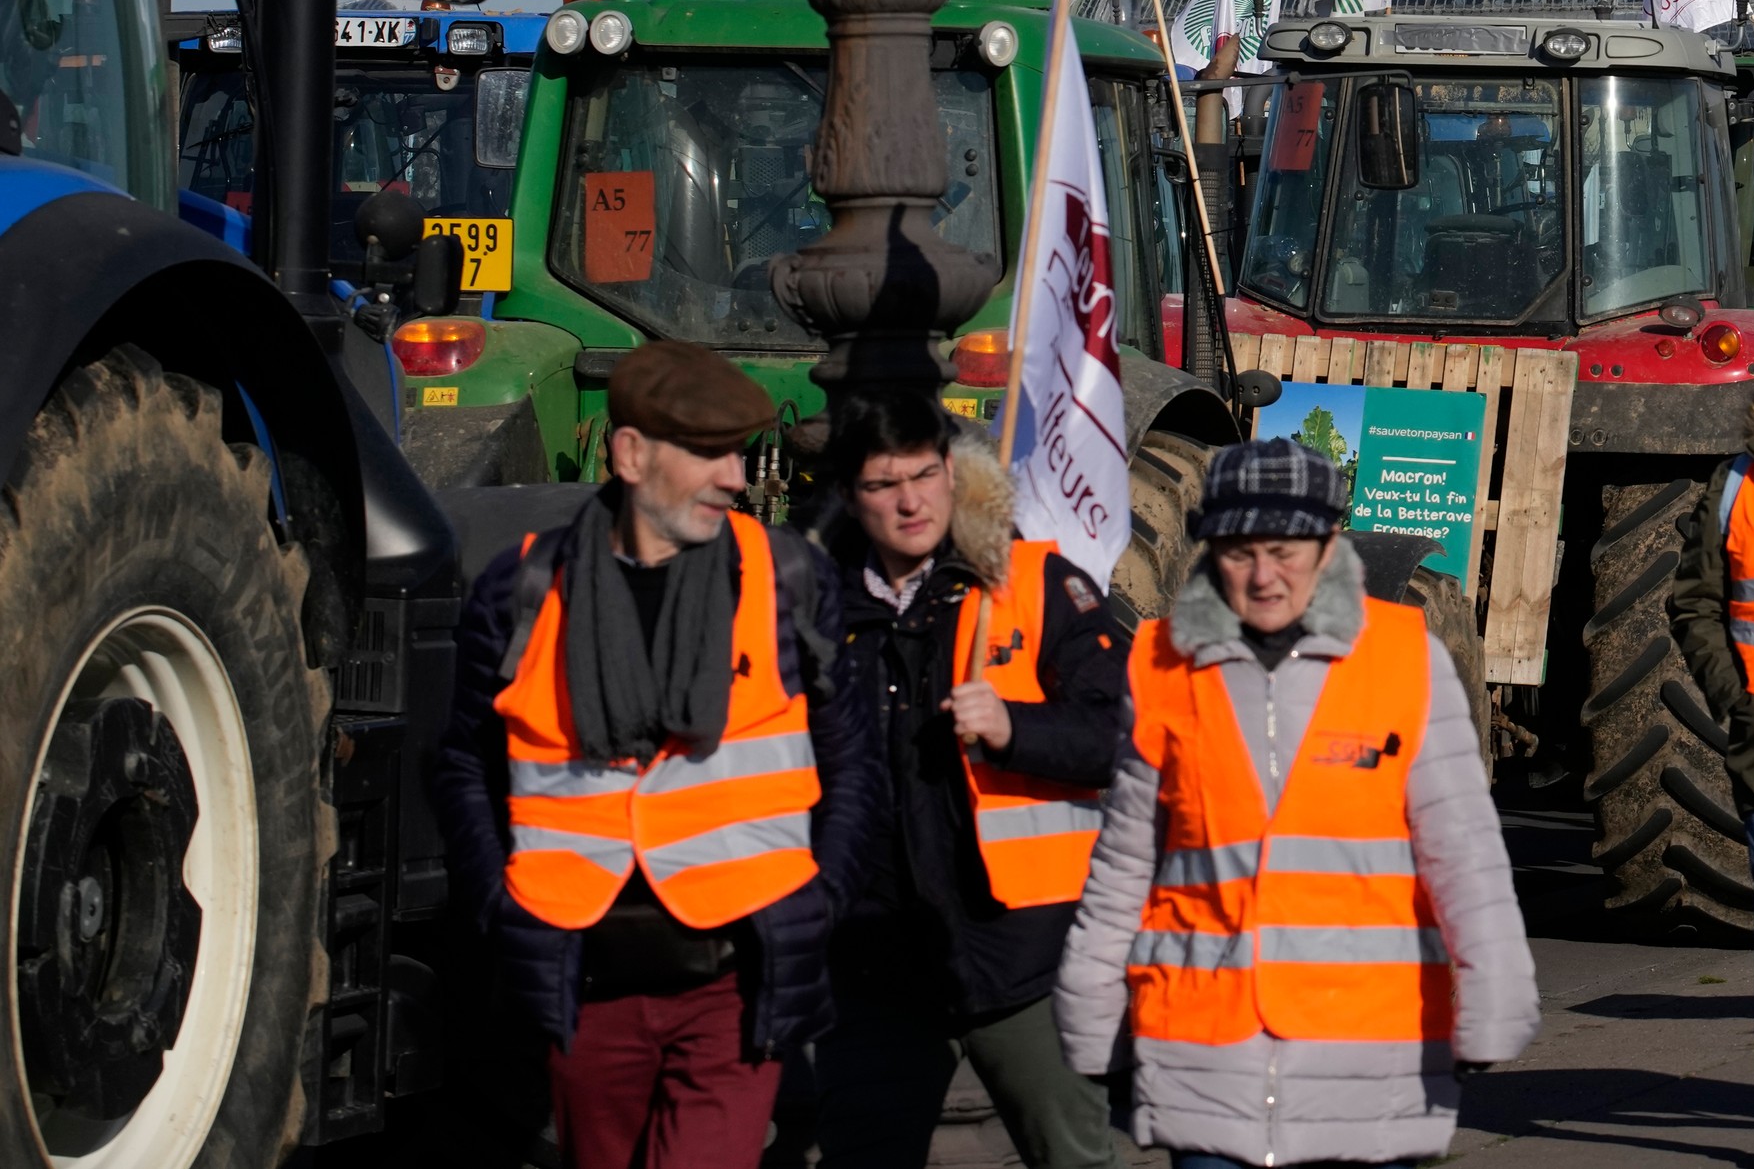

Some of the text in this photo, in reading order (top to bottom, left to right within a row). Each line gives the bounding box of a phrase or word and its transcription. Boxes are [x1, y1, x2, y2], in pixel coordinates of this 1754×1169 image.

[1296, 128, 1315, 147] 77
[592, 188, 626, 212] A5
[624, 230, 652, 252] 77
[1368, 425, 1462, 441] #sauvetonpaysan
[1380, 469, 1447, 485] Macron!
[1364, 487, 1467, 505] Veux-tu la fin
[1354, 503, 1472, 523] de la Betterave
